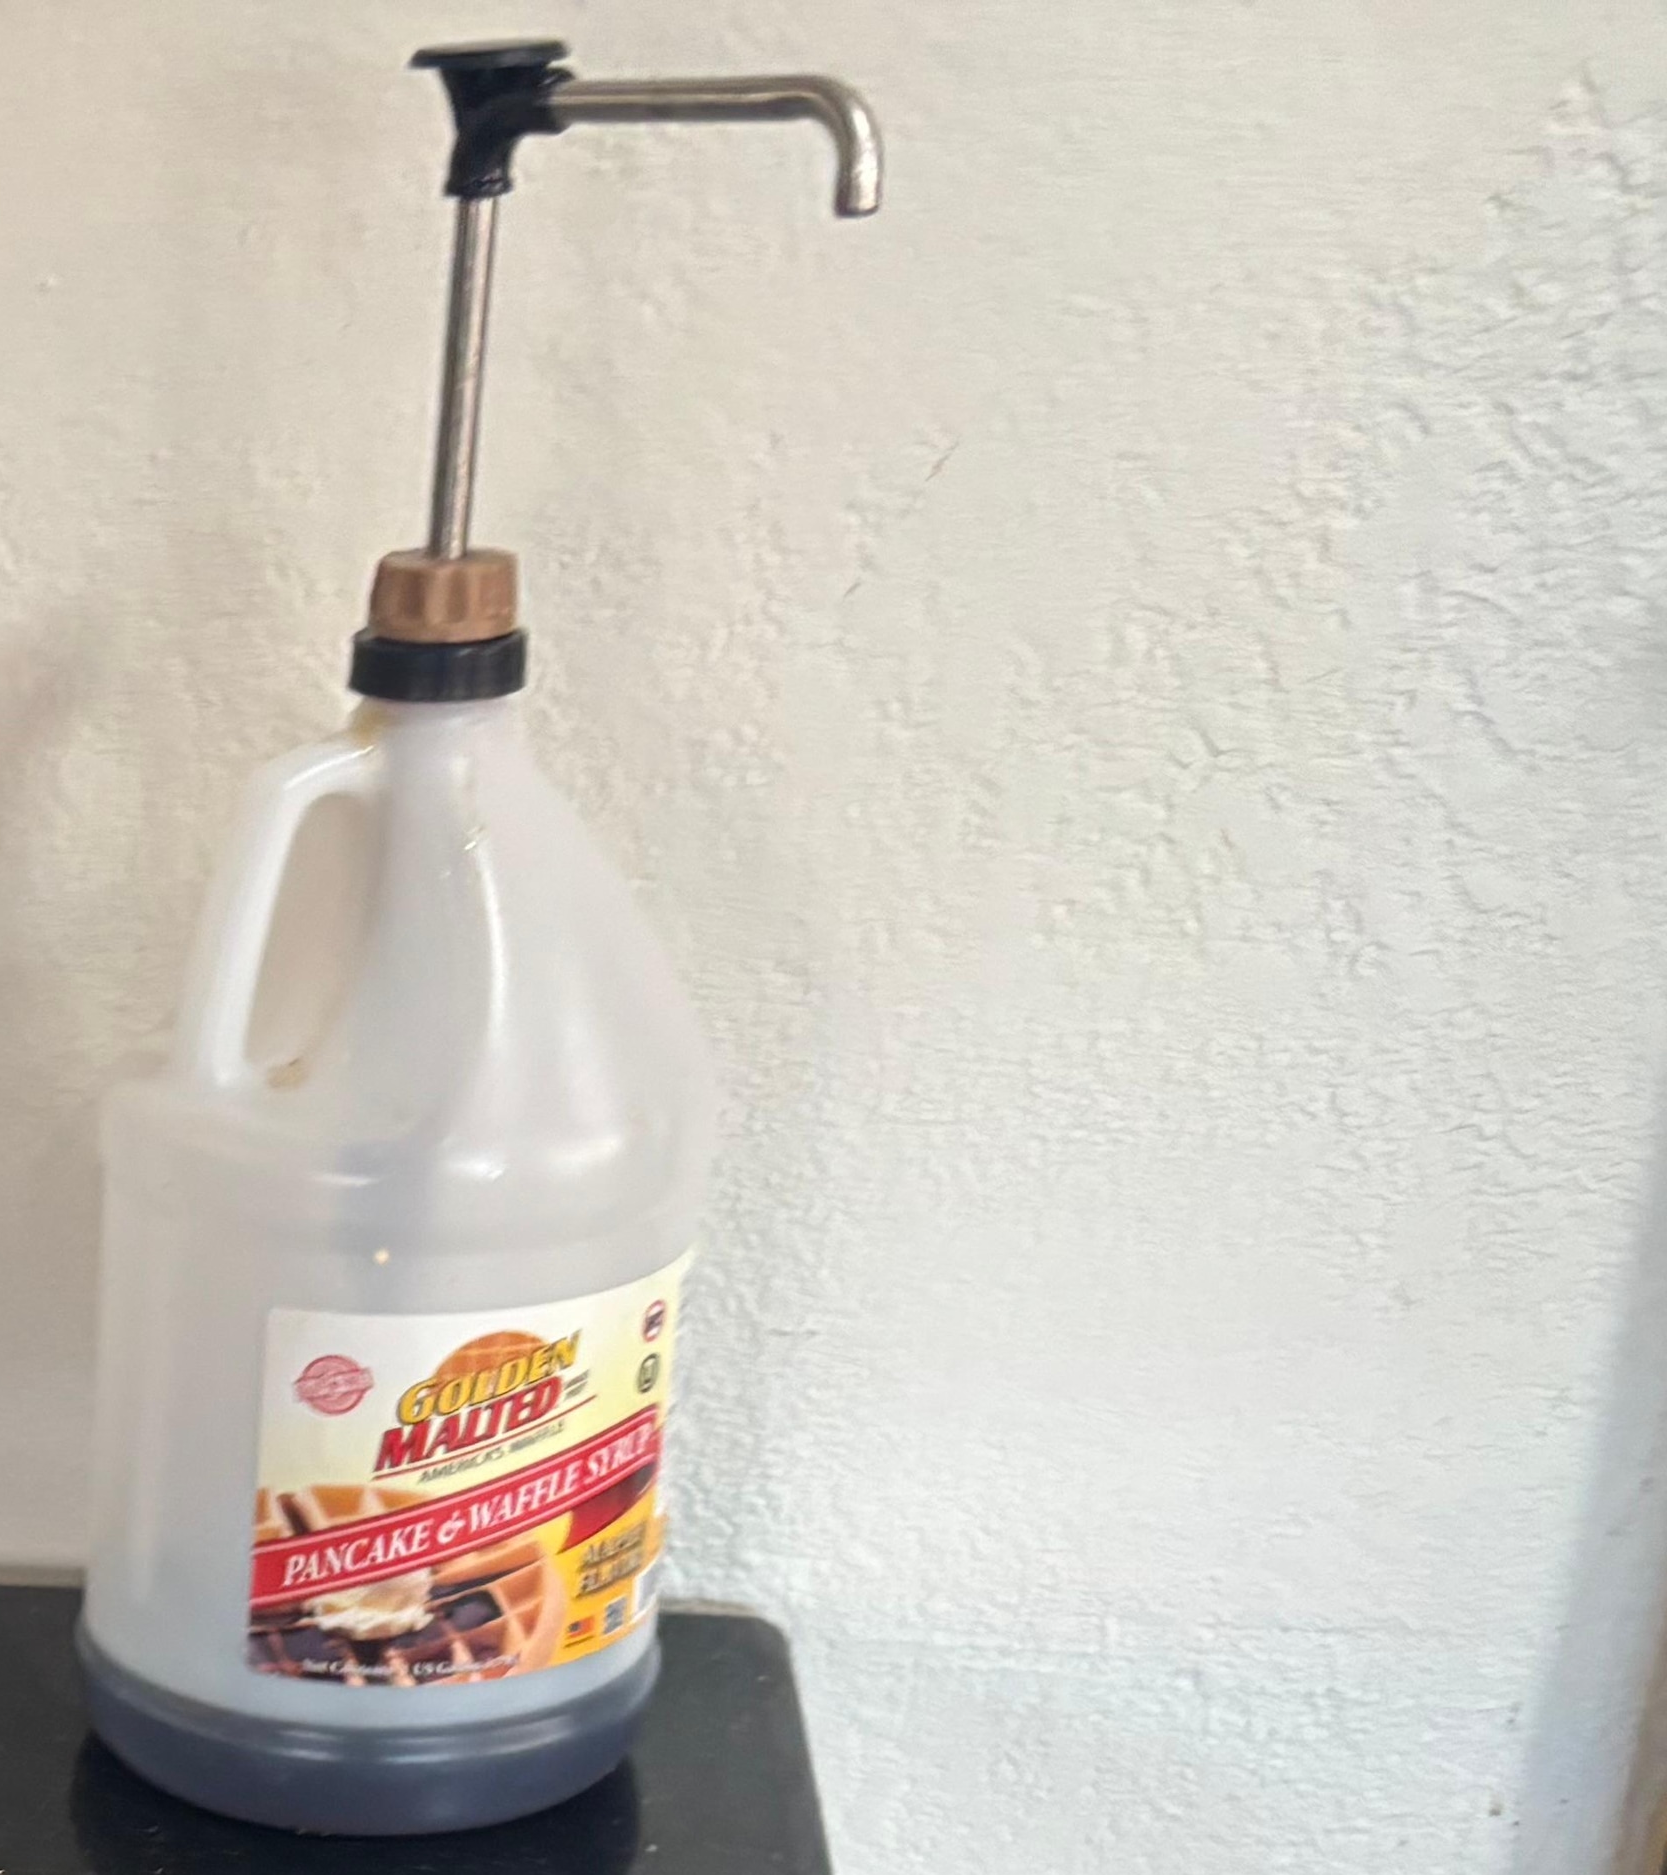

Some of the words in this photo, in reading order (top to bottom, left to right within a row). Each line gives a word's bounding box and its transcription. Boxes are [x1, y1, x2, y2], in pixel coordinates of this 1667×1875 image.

[373, 1375, 563, 1473] MALTED
[395, 1329, 582, 1426] GOLDEN
[280, 1517, 434, 1589] PANCAKE
[436, 1509, 466, 1545] &
[468, 1459, 580, 1534] WAFFLE
